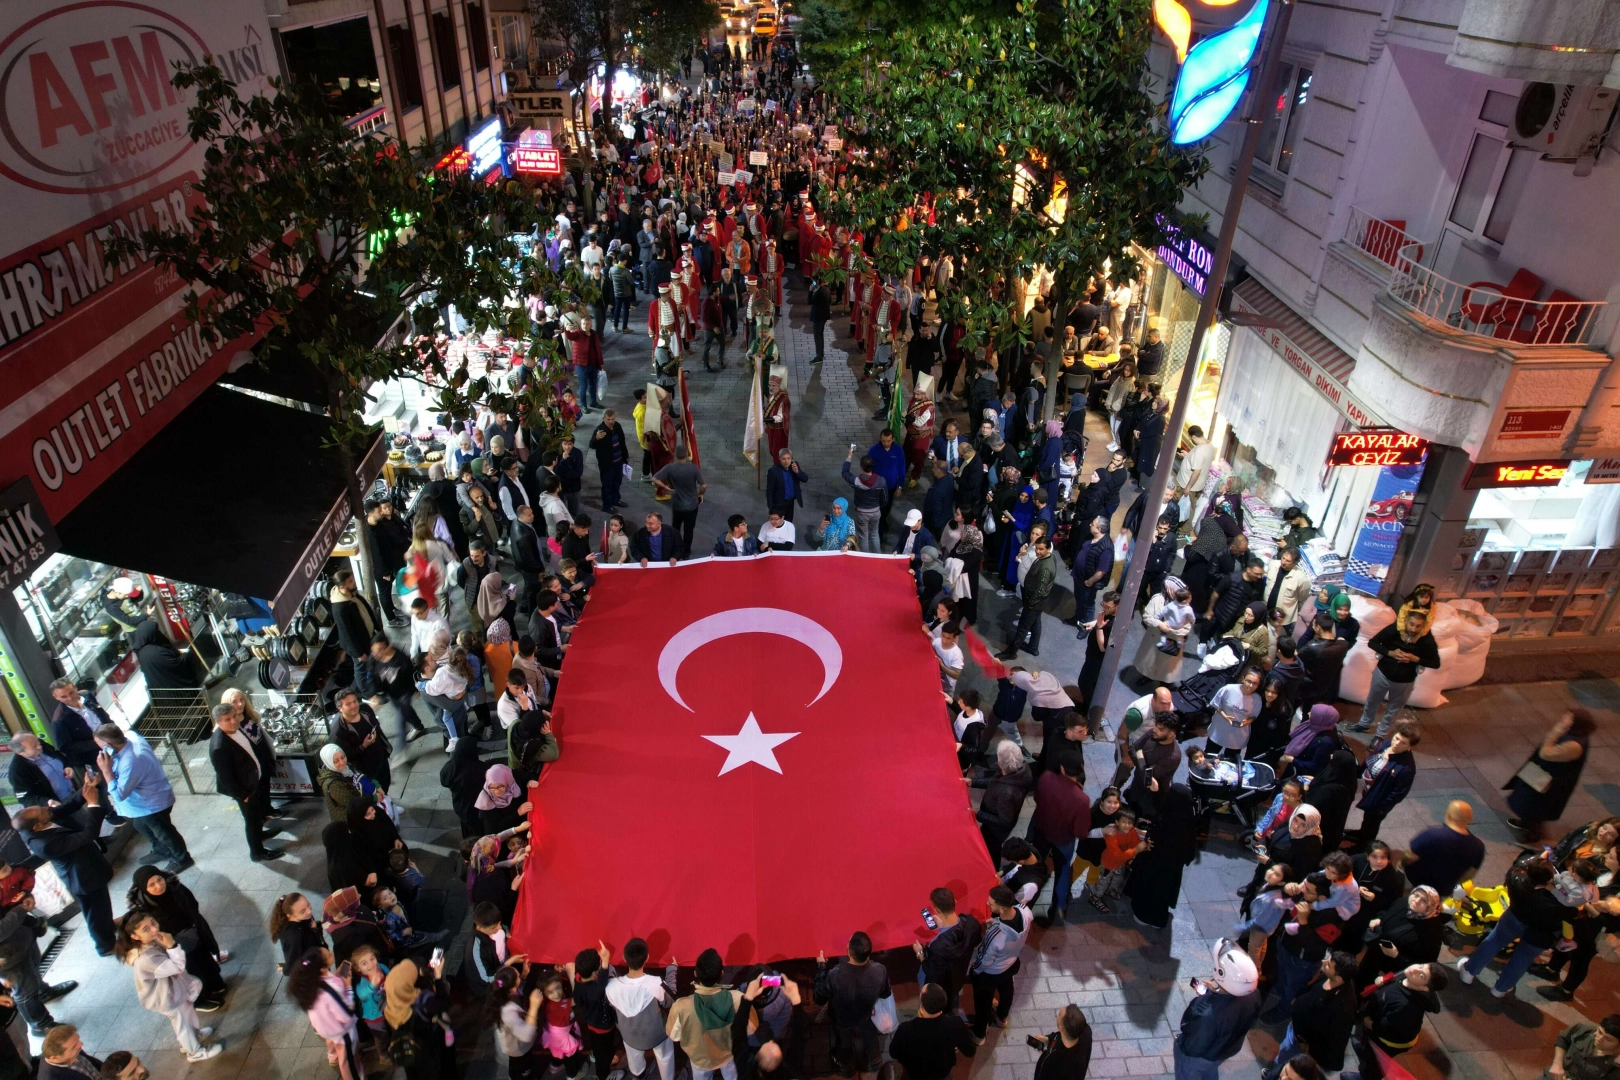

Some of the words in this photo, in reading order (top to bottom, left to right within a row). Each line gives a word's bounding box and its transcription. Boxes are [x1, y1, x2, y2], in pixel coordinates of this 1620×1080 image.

[29, 31, 176, 149] AFM
[1553, 84, 1575, 131] arçelik
[106, 119, 182, 163] ZÜCCACİYE
[518, 151, 556, 161] TABLET
[1158, 245, 1207, 296] DONDURM
[1270, 333, 1280, 349] VE
[1284, 344, 1312, 377] YORGAN
[1315, 374, 1342, 404] DİKİMİ
[32, 381, 131, 491] OUTLET
[126, 320, 213, 417] FABRİKA
[1342, 435, 1419, 448] KAYALAR
[1498, 466, 1537, 481] Yeni
[13, 556, 28, 575] 47
[29, 542, 45, 561] 83
[304, 524, 333, 578] OUTLET
